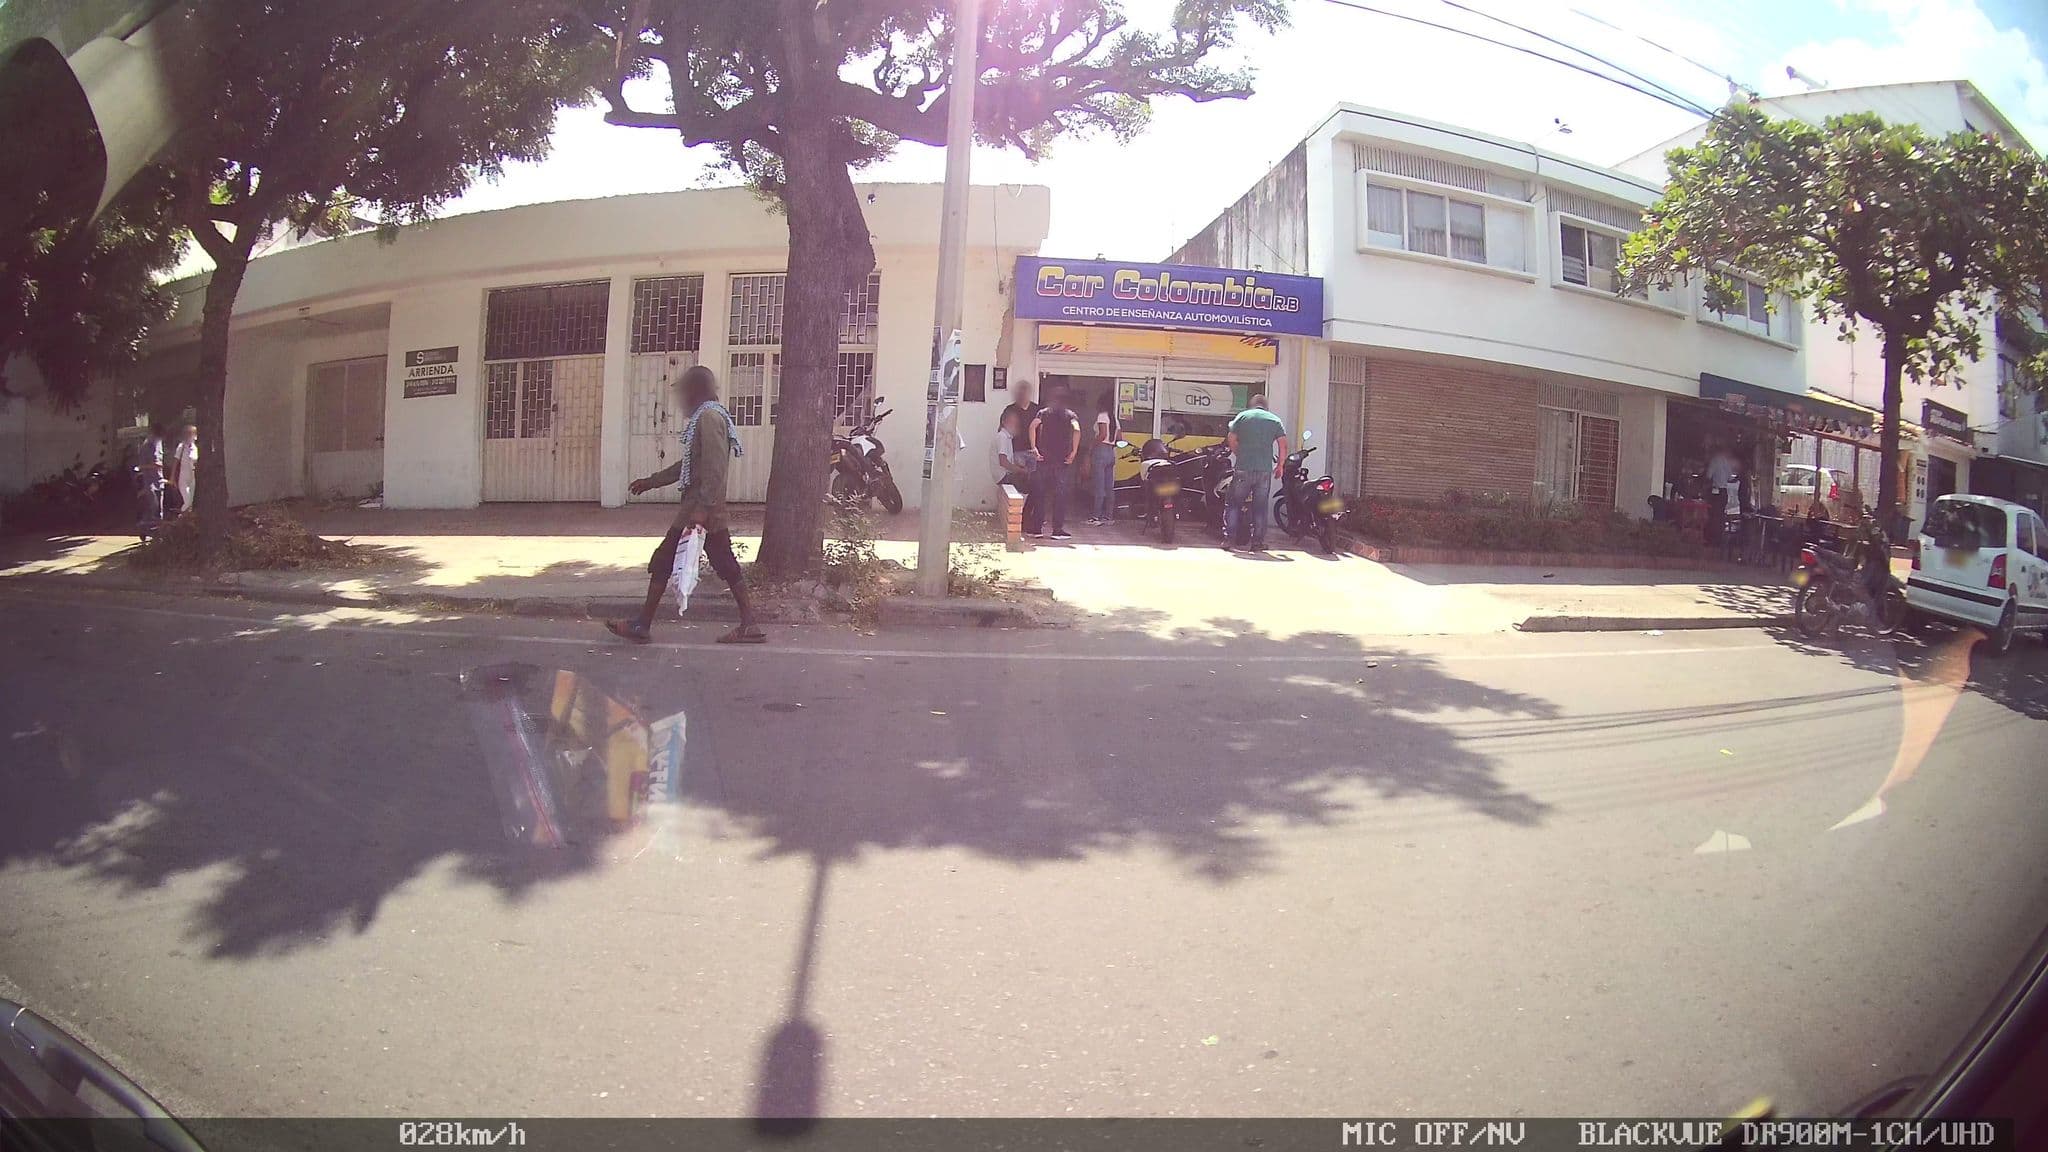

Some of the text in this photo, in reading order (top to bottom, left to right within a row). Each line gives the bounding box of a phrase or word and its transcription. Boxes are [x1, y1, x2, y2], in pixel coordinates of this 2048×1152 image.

[1036, 266, 1104, 298] Car
[1112, 270, 1274, 310] Colombia
[1062, 306, 1273, 328] CENTRO DE ENSEÑANZA AUTOMOVILÍSTICA
[409, 364, 454, 377] ARRIENDA
